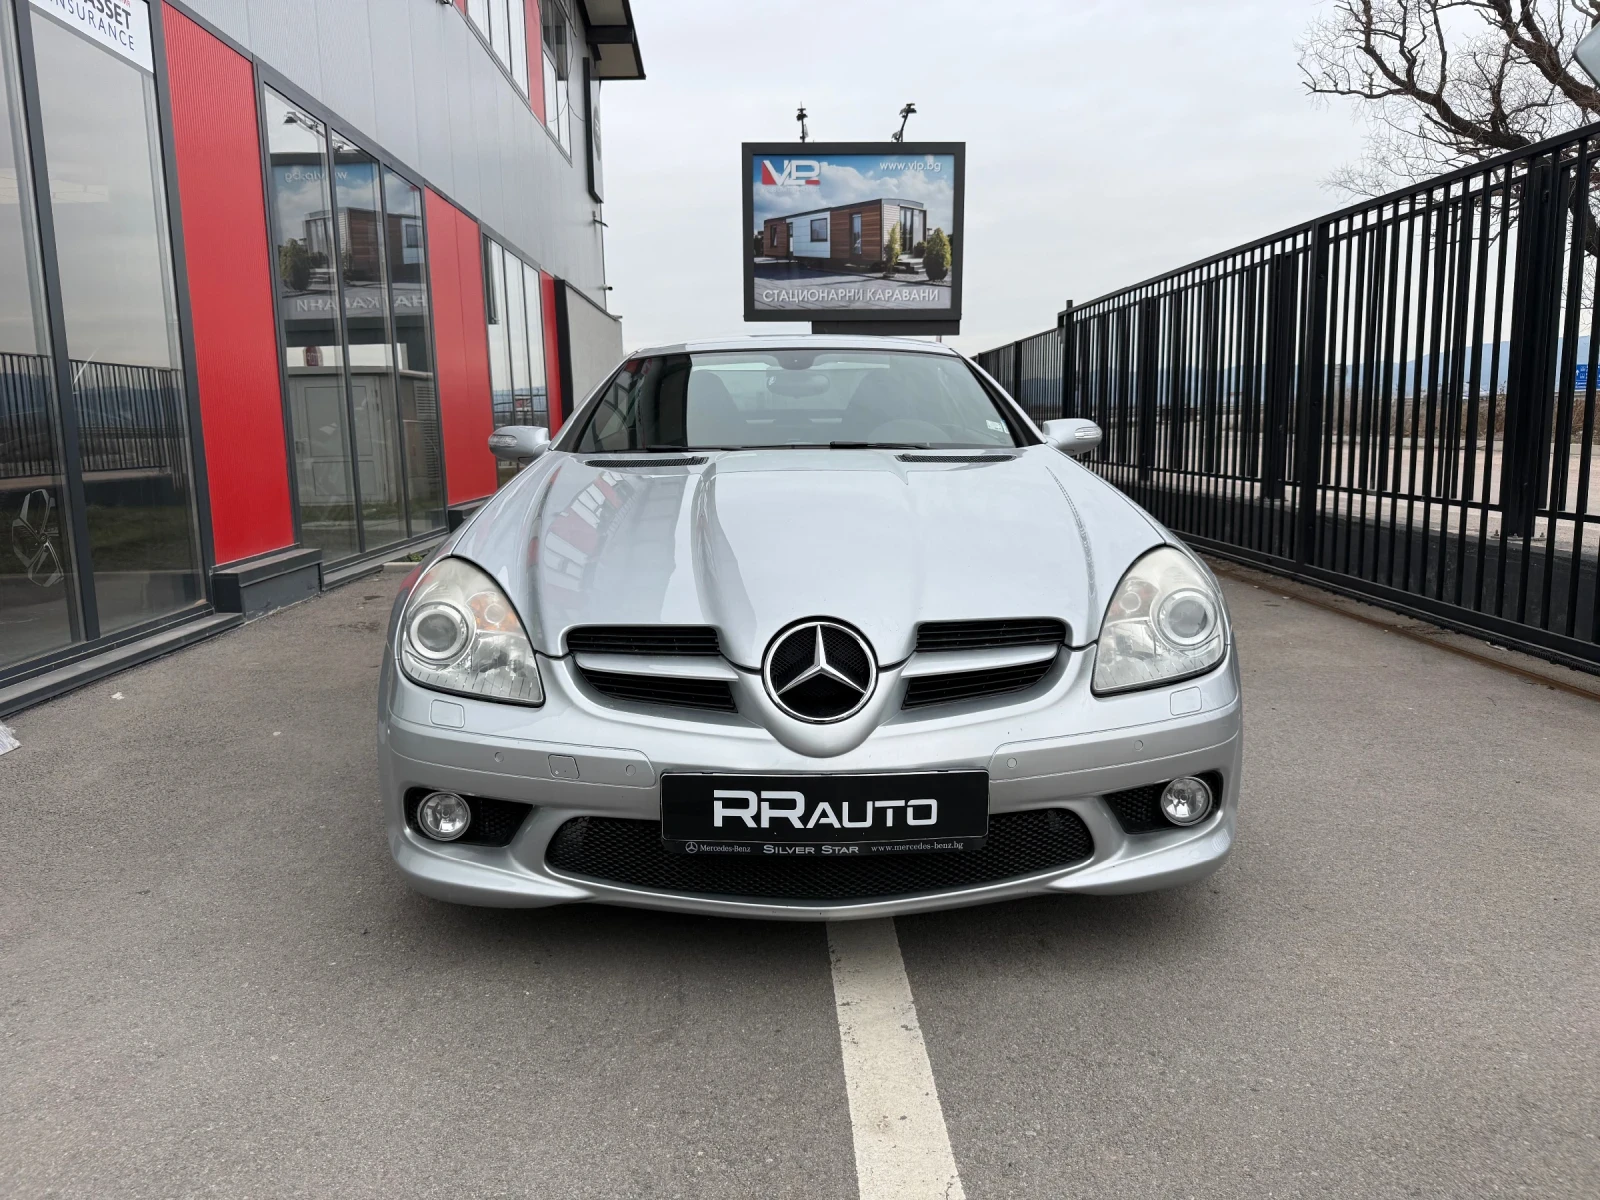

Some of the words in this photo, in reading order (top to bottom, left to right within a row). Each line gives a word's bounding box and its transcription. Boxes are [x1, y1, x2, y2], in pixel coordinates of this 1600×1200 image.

[50, 0, 135, 51] NSURANCE
[879, 160, 942, 173] www.vlp.bg
[762, 288, 863, 303] СТАЦИОНАРНИ
[866, 288, 940, 301] КАРАВАНИ
[699, 844, 751, 853] Mercedes-Benz
[763, 844, 815, 855] SILVER
[821, 845, 859, 854] STAR
[870, 840, 964, 852] www.mercedes-benz.bg
